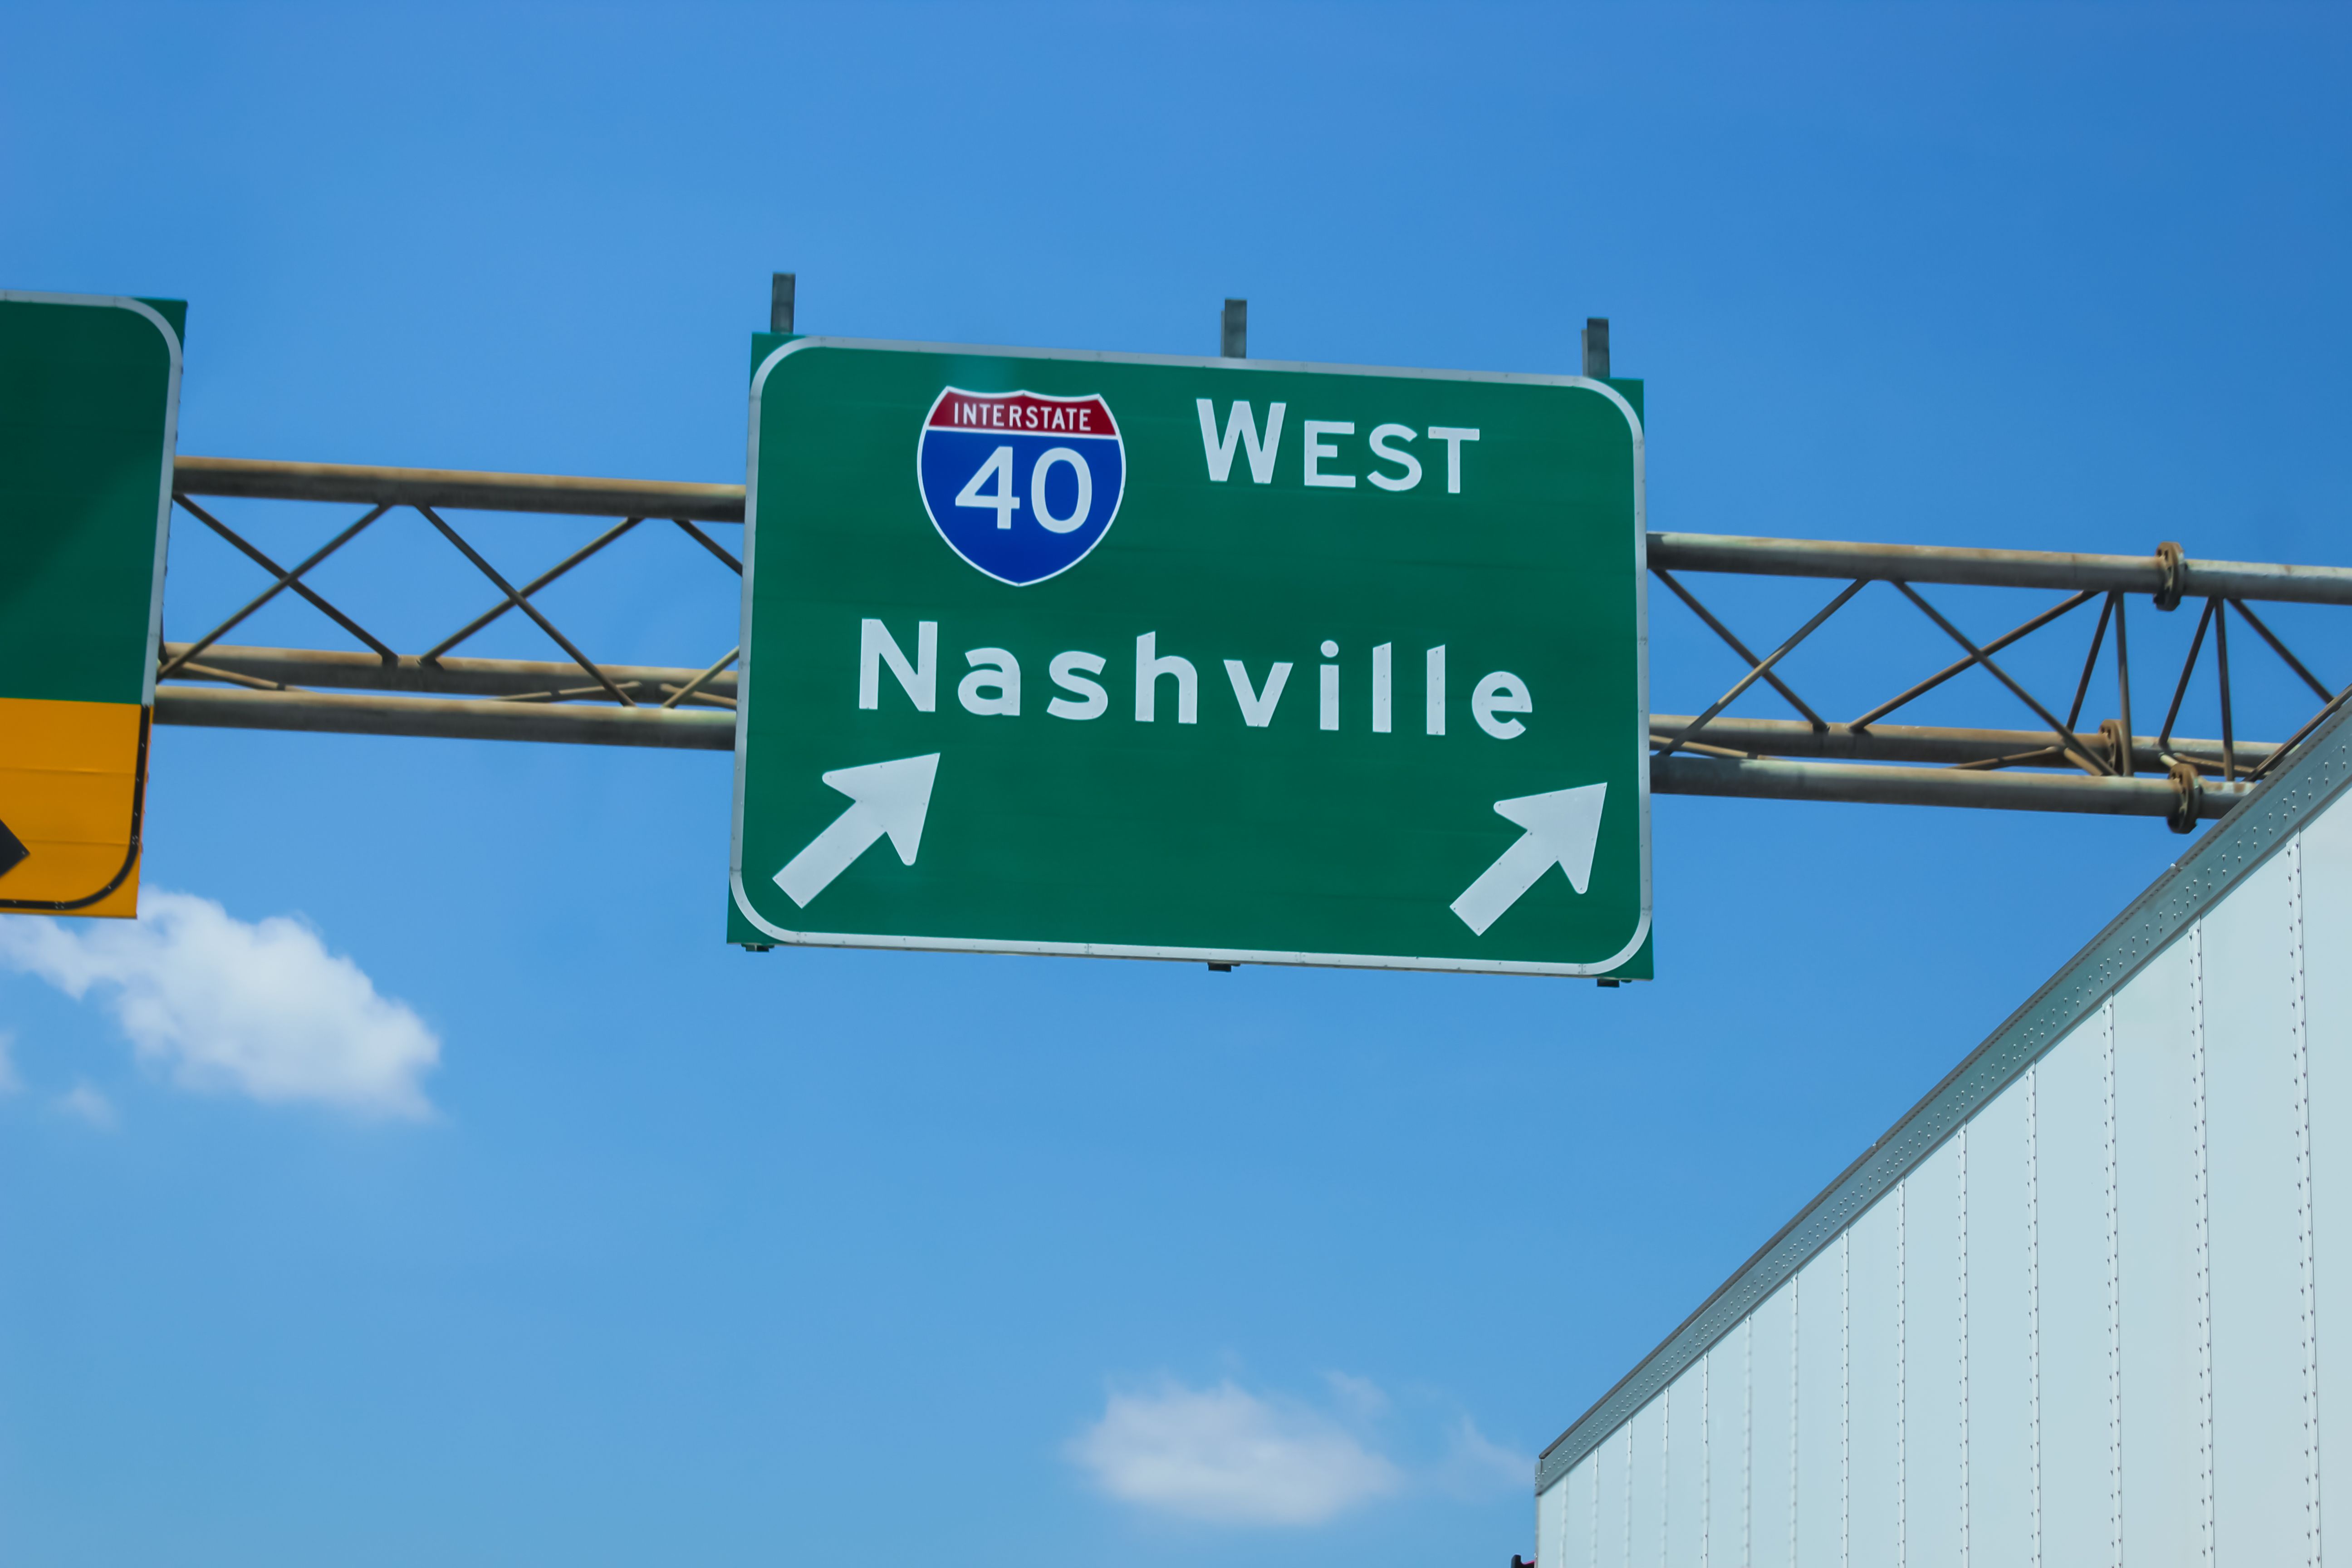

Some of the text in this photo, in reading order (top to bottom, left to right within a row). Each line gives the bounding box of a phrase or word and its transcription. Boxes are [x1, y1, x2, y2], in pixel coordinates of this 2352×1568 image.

[954, 401, 1092, 431] INTERSTATE
[1196, 398, 1480, 494] WEST
[955, 446, 1092, 533] 40
[858, 618, 1533, 740] Nashville
